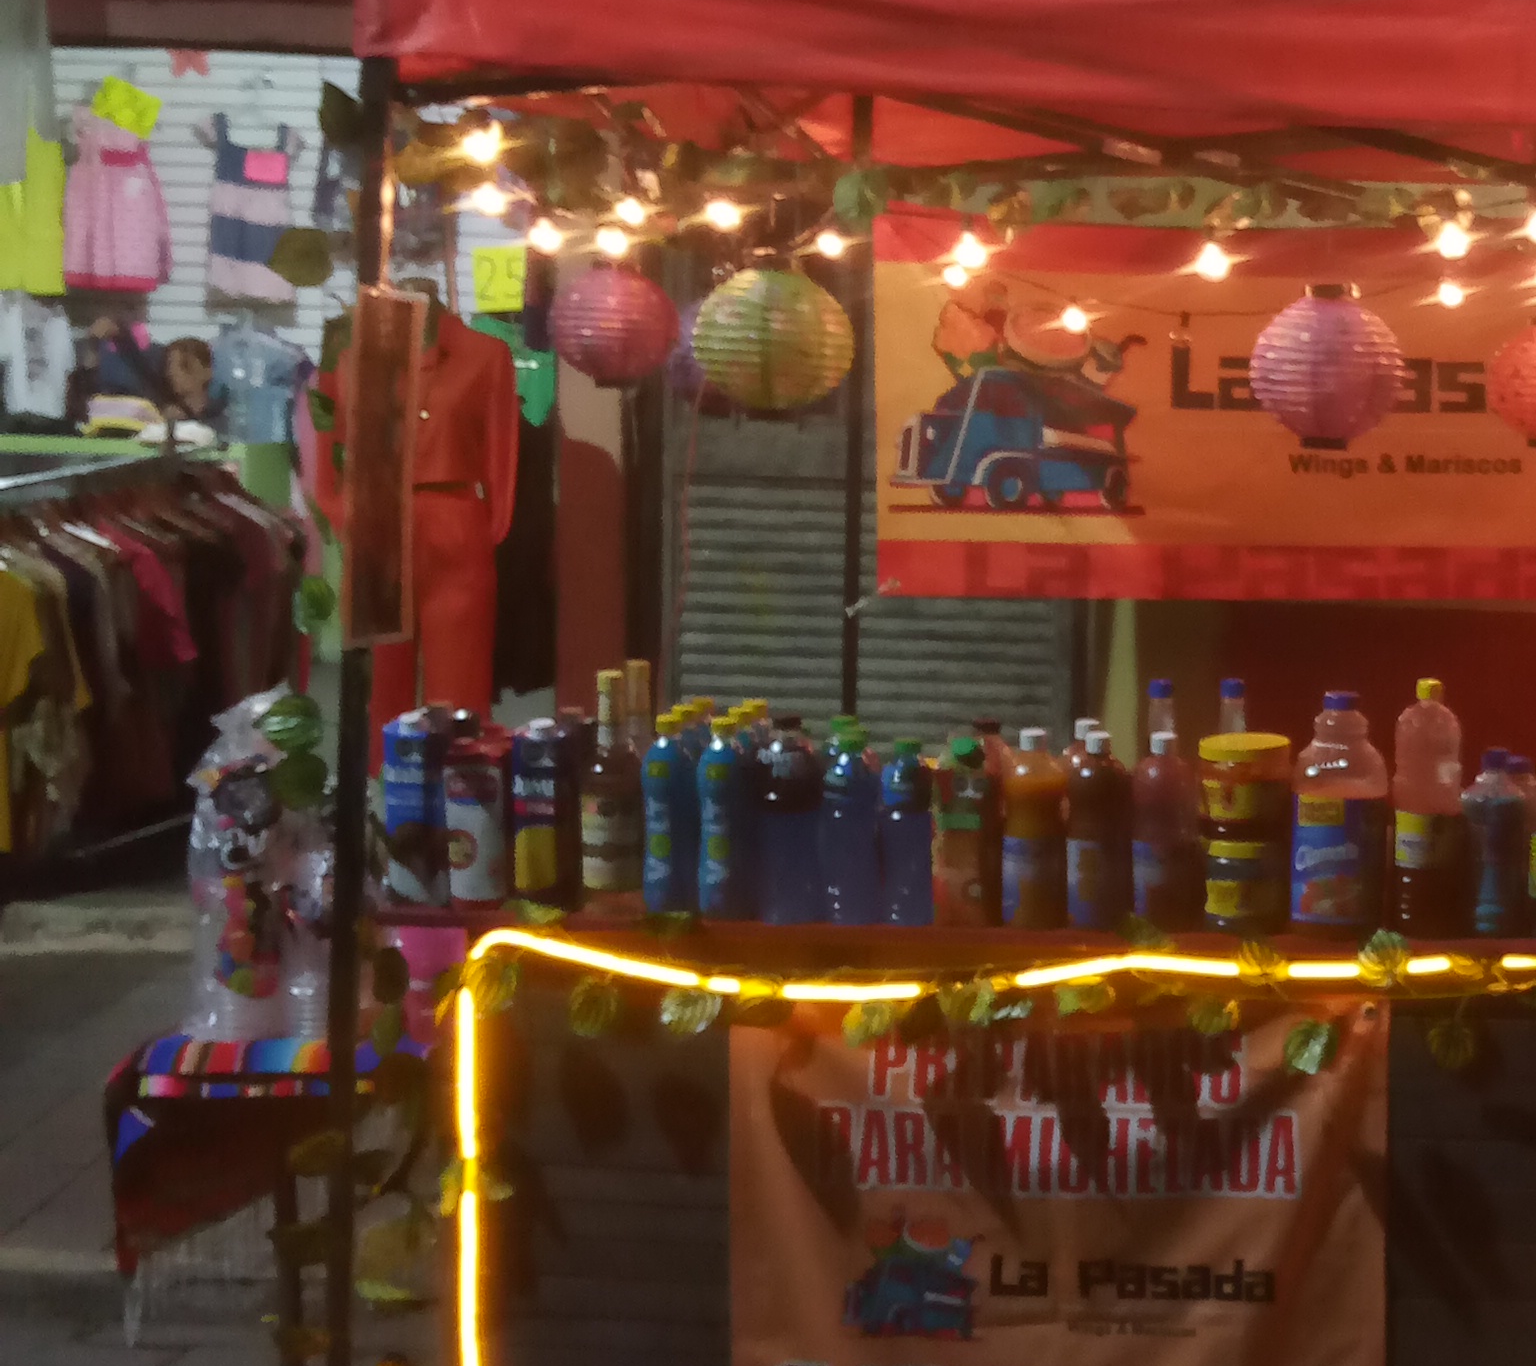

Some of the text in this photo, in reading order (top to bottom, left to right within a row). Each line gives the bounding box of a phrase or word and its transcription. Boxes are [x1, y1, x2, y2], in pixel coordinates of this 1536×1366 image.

[1171, 346, 1262, 411] La
[1289, 453, 1522, 479] Wings & Mariscos
[870, 1029, 1245, 1104] PRPARAS
[818, 1103, 970, 1190] PARA
[989, 1253, 1276, 1302] La Pasada
